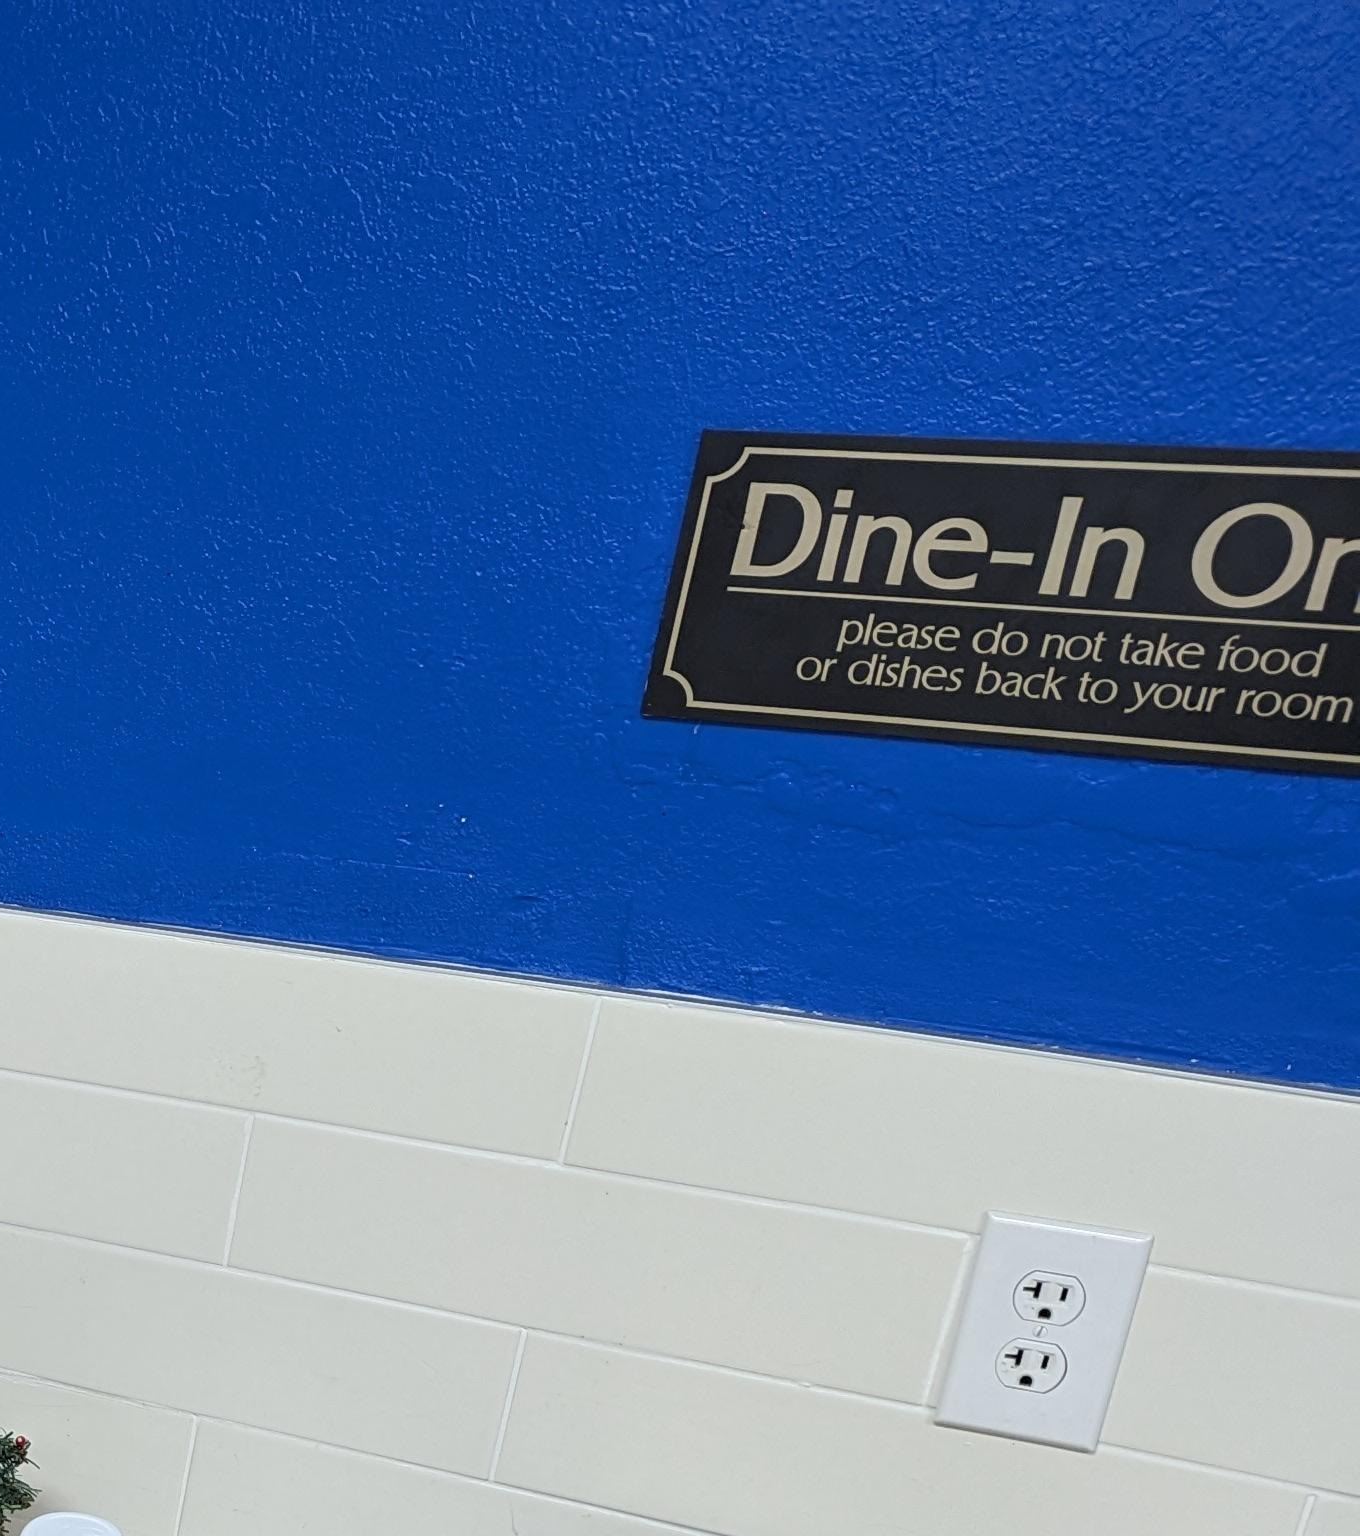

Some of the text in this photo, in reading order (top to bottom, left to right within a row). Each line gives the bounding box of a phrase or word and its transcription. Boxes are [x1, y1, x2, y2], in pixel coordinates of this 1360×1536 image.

[729, 481, 1146, 601] Dine-In
[836, 613, 1328, 678] please do not take food
[796, 653, 1354, 723] or dishes back to your room
